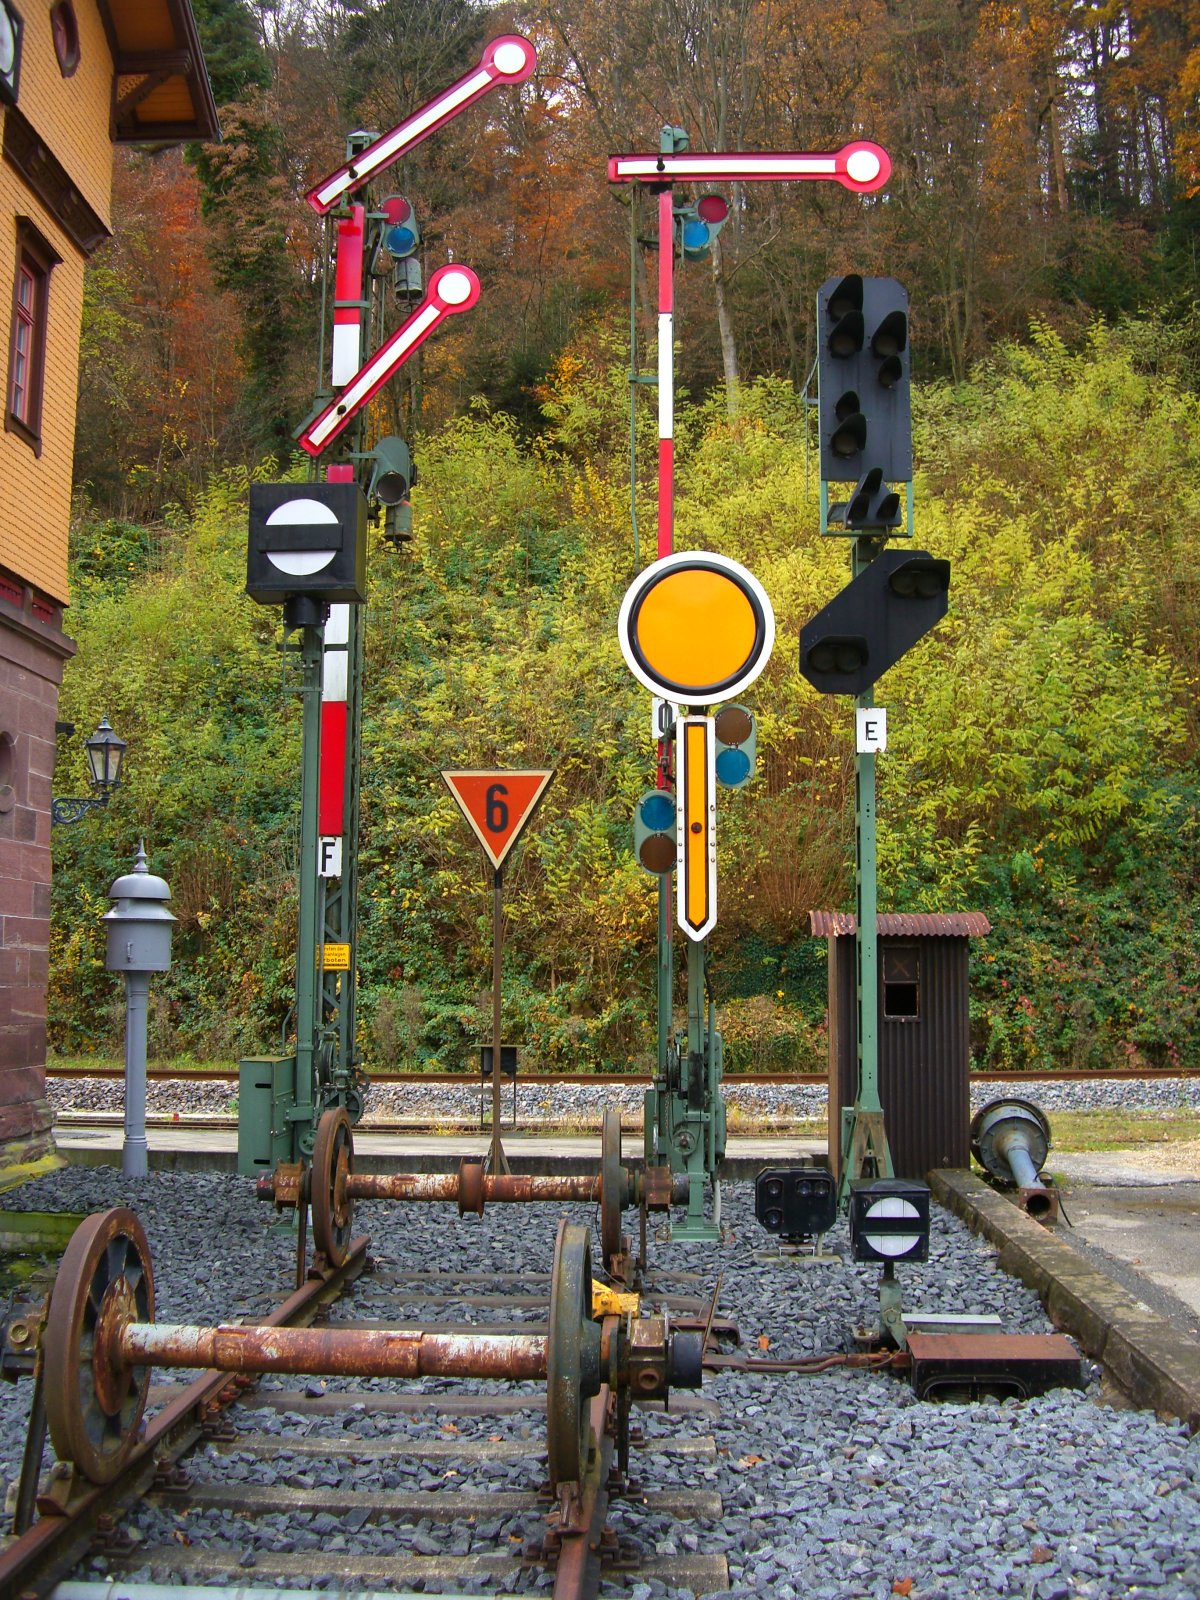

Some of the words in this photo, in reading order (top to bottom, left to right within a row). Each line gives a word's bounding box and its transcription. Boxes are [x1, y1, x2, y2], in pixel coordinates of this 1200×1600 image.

[865, 721, 878, 741] E
[486, 783, 509, 833] 6
[321, 841, 336, 872] F
